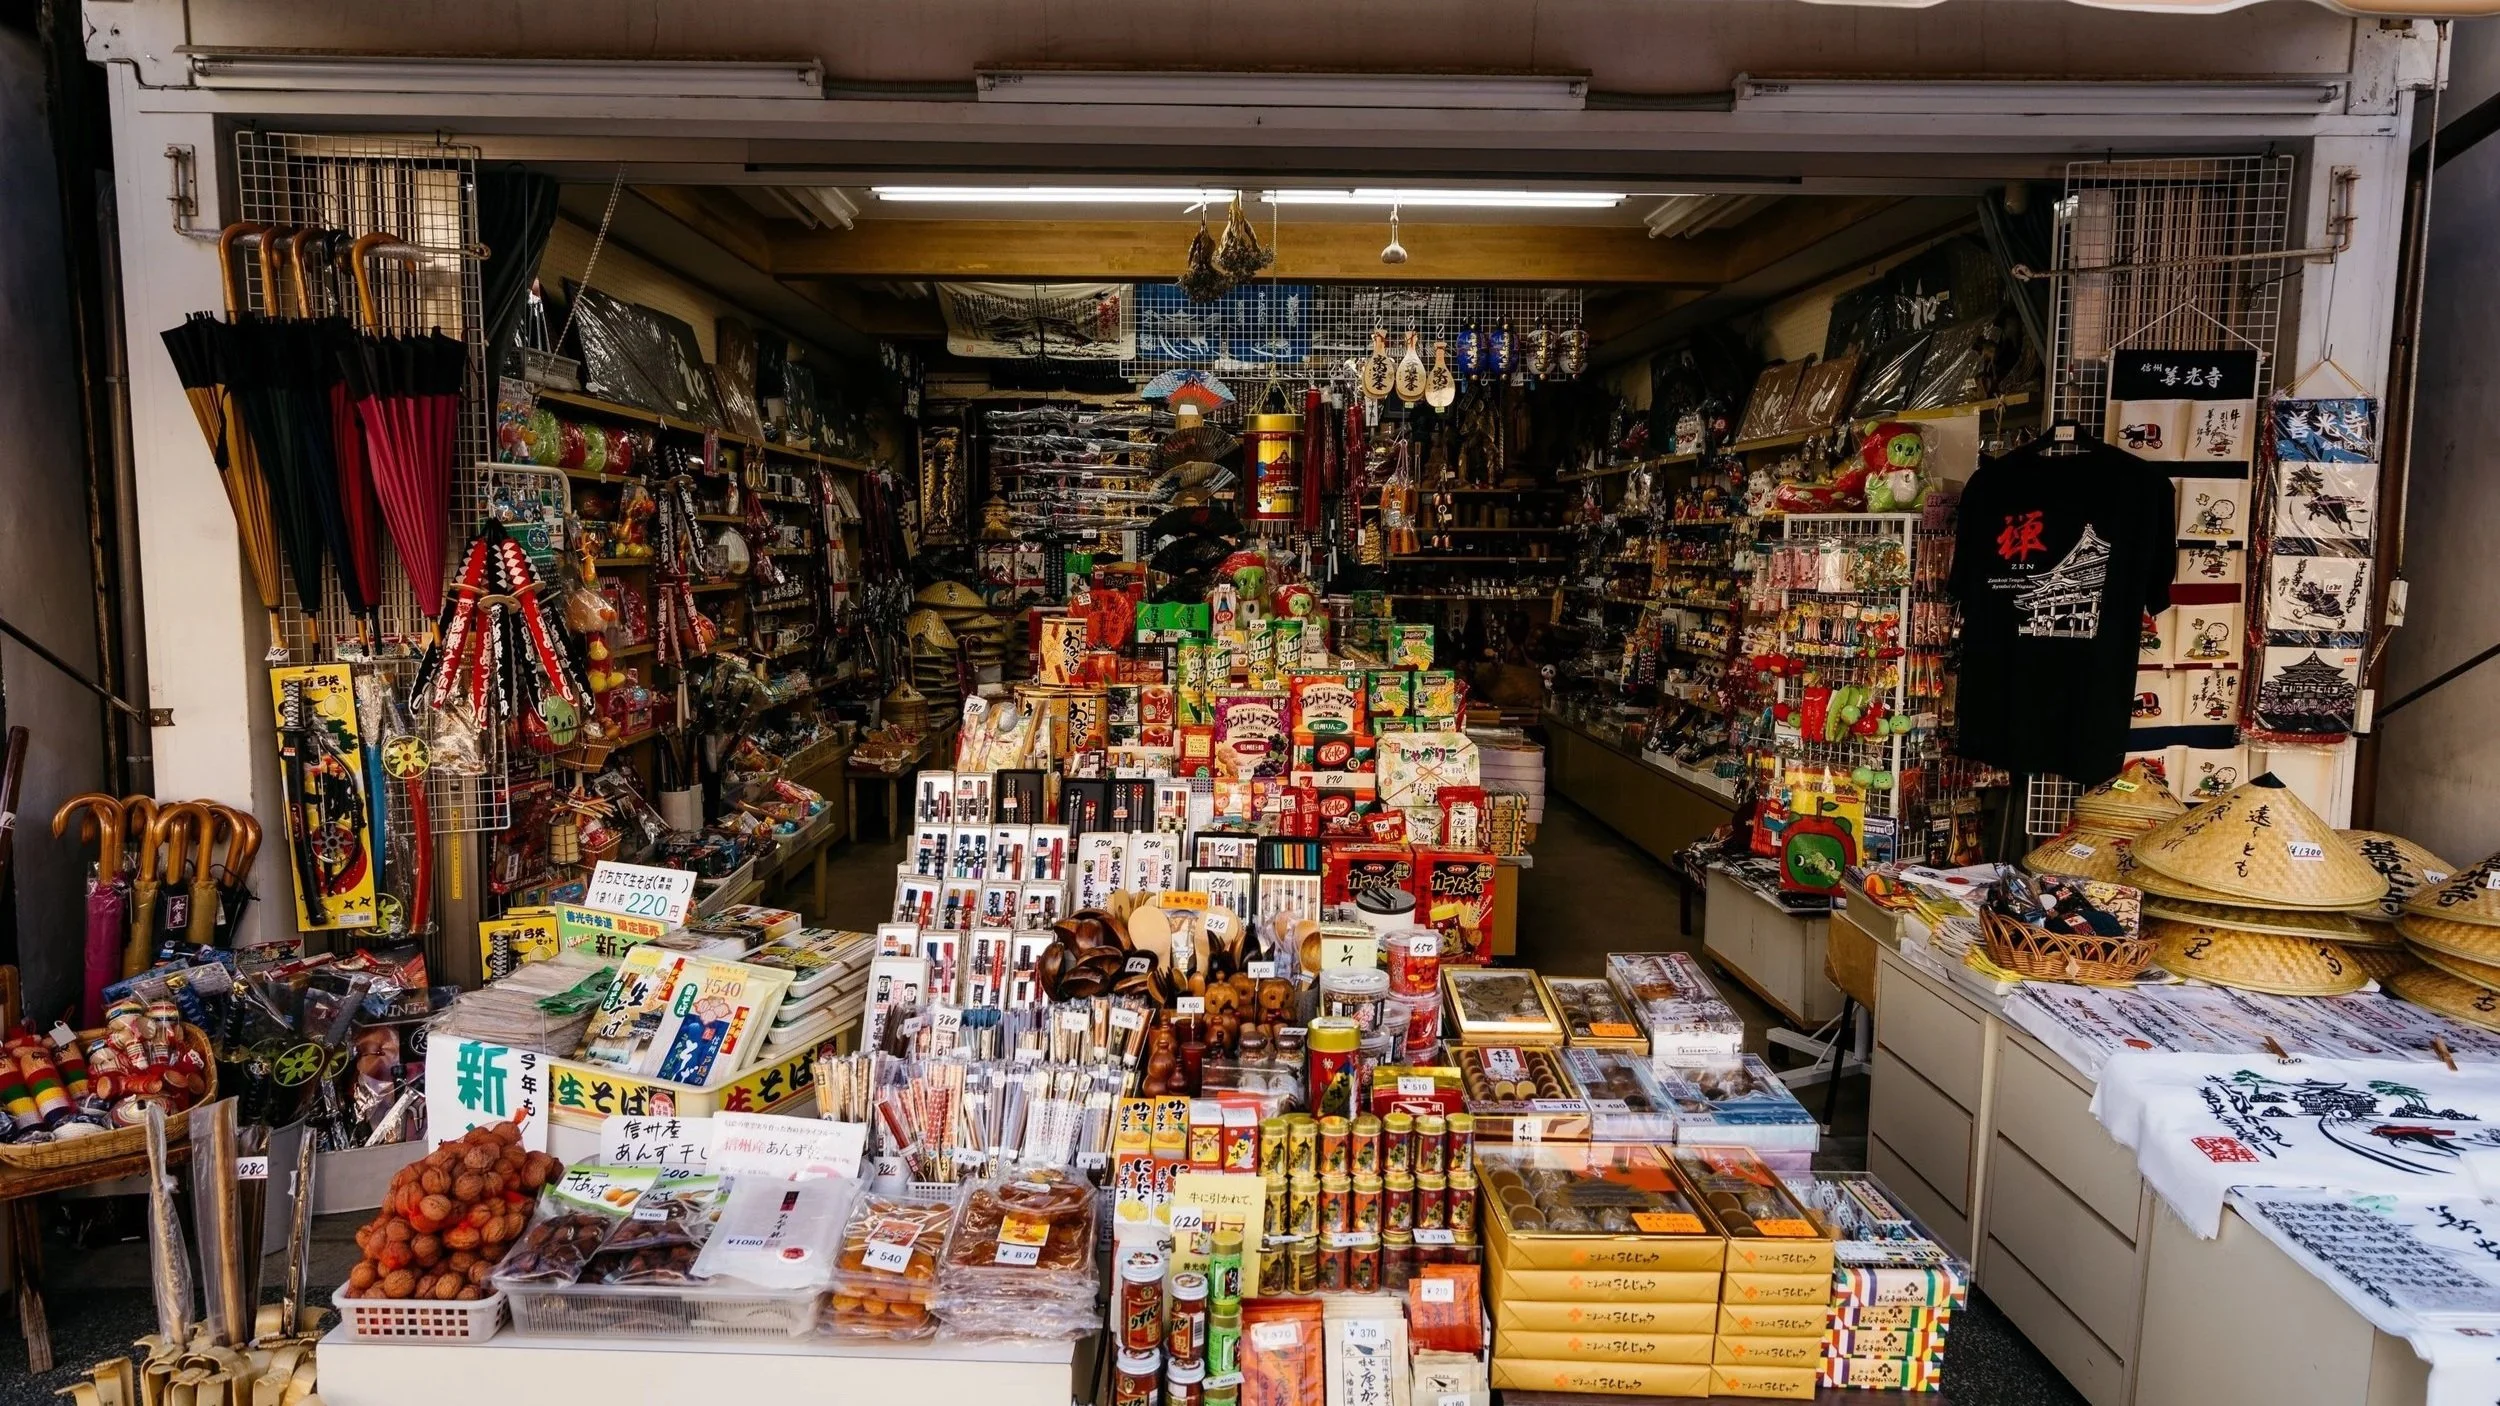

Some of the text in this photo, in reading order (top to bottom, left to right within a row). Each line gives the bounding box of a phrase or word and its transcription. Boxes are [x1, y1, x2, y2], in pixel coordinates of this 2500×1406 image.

[2141, 362, 2223, 390] 信州 善光寺
[2287, 410, 2368, 441] 善光寺
[1379, 676, 1400, 684] Jagabee
[1424, 676, 1445, 684] Jagabee
[1300, 690, 1358, 710] カントリーマアム
[1224, 711, 1282, 732] カントリーマアム
[1323, 746, 1346, 761] KitKat
[1400, 746, 1458, 764] じゃがりこ
[1325, 801, 1346, 816] KitKat
[1095, 839, 1113, 848] 500
[1143, 840, 1161, 849] 500
[1217, 844, 1236, 853] 540
[1211, 878, 1232, 889] 540
[1431, 870, 1485, 896] カラムーチョ
[617, 918, 660, 937] 限定販売
[536, 937, 553, 945] セット
[1414, 943, 1433, 953] 650
[704, 978, 742, 998] ¥540
[457, 1040, 509, 1132] 新
[521, 1053, 538, 1117] 今年も
[557, 1072, 649, 1117] 生そば
[1413, 1083, 1427, 1091] 510
[1119, 1104, 1131, 1132] 唐辛子
[1133, 1102, 1151, 1122] ゆず
[1155, 1103, 1167, 1132] 唐辛子
[1168, 1100, 1187, 1120] ゆず
[624, 1119, 682, 1139] 信州産
[1119, 1163, 1131, 1201] 唐辛子
[1133, 1158, 1153, 1204] にんにく
[1155, 1167, 1168, 1204] 唐辛子
[728, 1238, 763, 1247] ¥1080
[880, 1253, 902, 1264] 540
[1015, 1252, 1037, 1260] 870
[1360, 1328, 1377, 1338] 370
